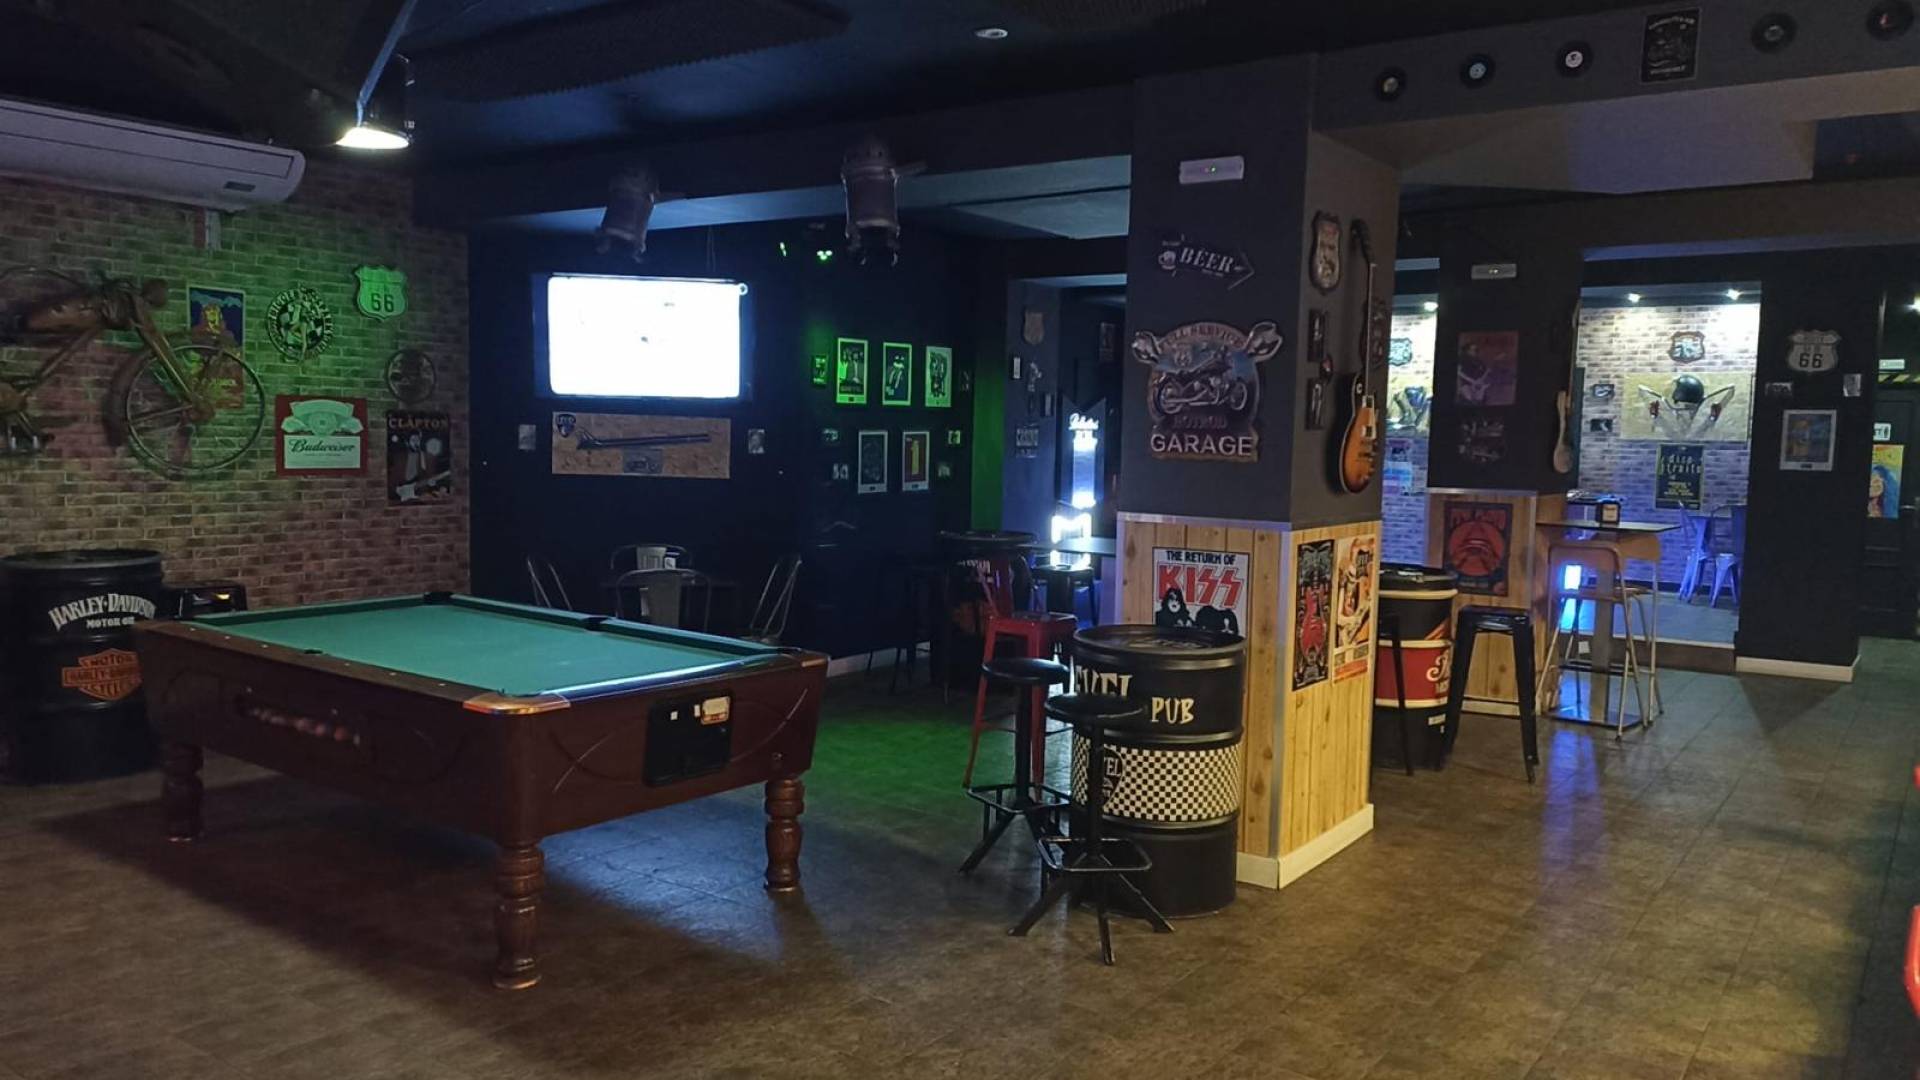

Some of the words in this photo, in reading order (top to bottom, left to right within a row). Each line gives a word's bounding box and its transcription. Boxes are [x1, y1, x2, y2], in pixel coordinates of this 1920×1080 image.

[1179, 246, 1234, 274] BEER
[371, 292, 394, 312] 66
[1799, 352, 1823, 369] 66
[288, 438, 356, 453] Budweiser
[1150, 433, 1253, 457] GARAGE
[1166, 550, 1182, 561] THE
[1185, 551, 1222, 565] RETURN
[1223, 554, 1236, 566] OF
[1158, 562, 1243, 609] KISS
[1151, 696, 1195, 724] PUB
